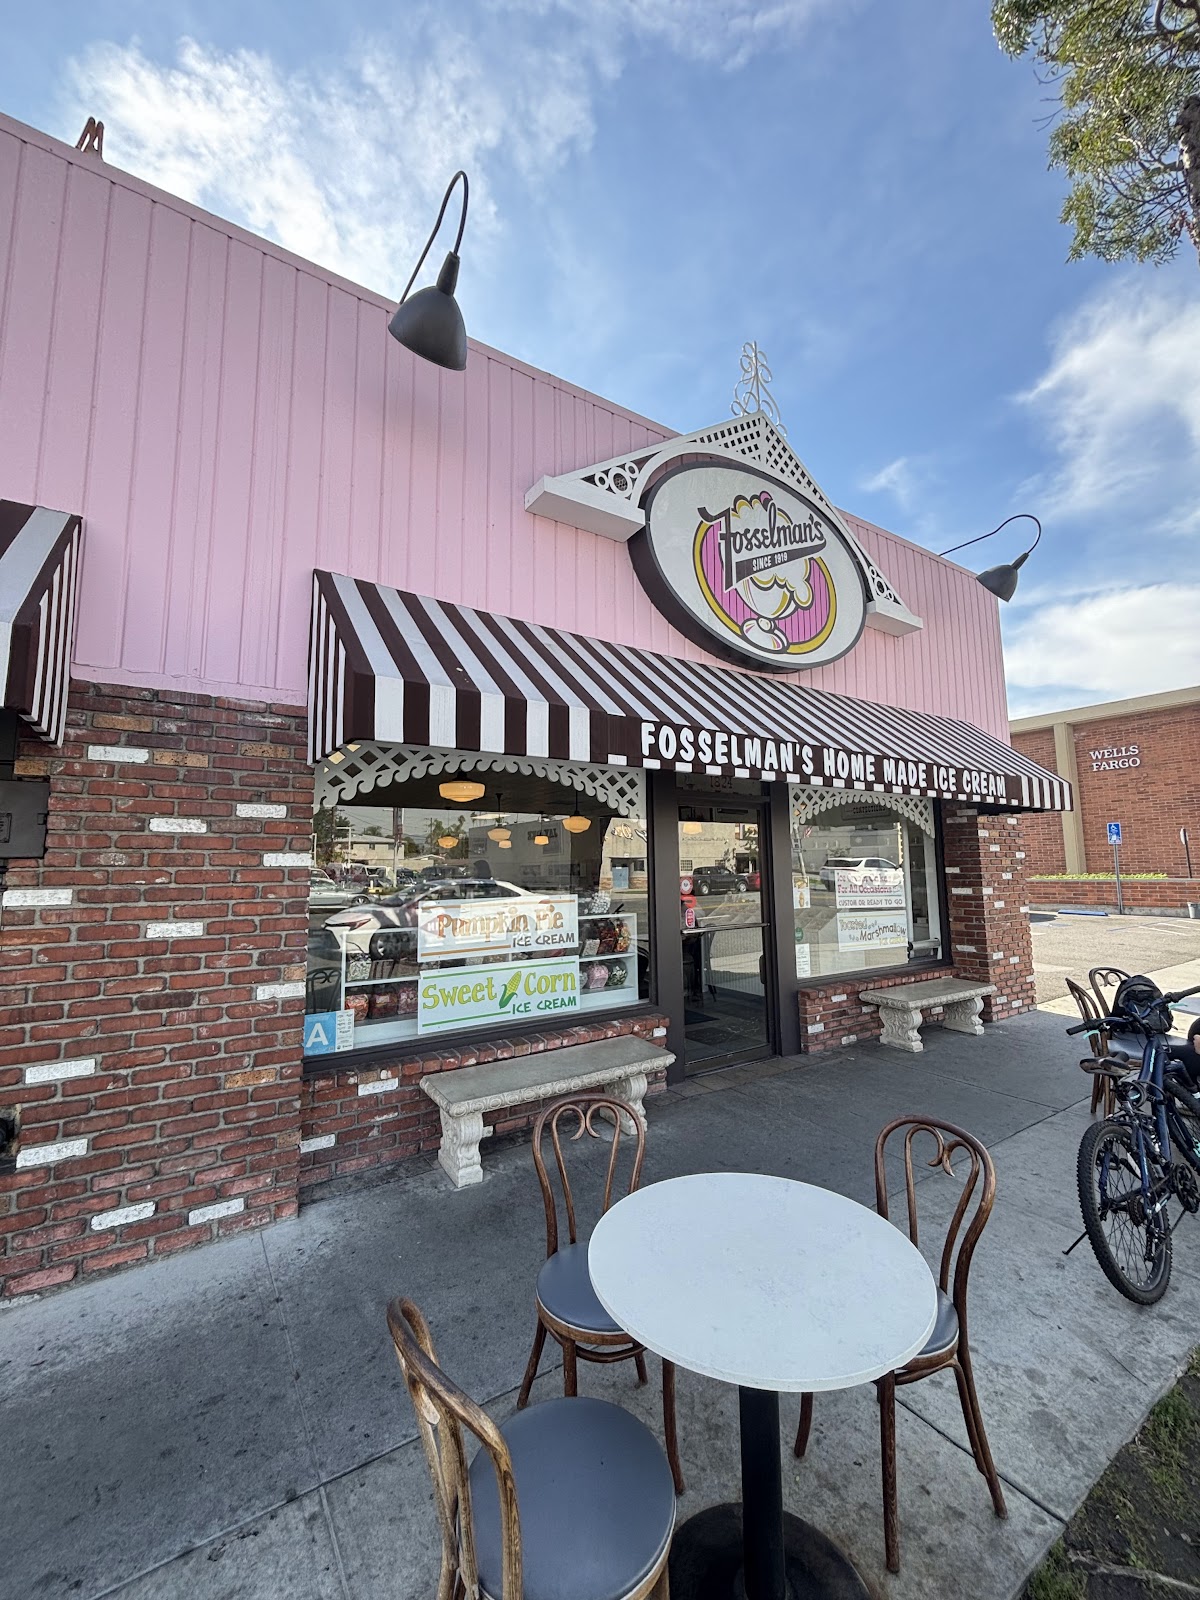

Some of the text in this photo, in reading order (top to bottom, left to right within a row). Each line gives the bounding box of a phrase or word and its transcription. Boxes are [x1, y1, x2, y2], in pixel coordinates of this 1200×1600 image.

[752, 551, 788, 571] SINCE 1919
[641, 722, 1006, 798] FOSSELMAN'S HOME MADE ICE CREAM
[1089, 745, 1139, 760] WELLS
[1091, 757, 1141, 772] FARGO
[710, 776, 733, 789] 1824
[436, 904, 564, 943] Pumpkin Pie
[512, 932, 575, 948] ICE CREAM
[422, 971, 577, 1010] Sweet Corn
[512, 996, 577, 1015] ICE CREAM
[305, 1022, 329, 1048] A
